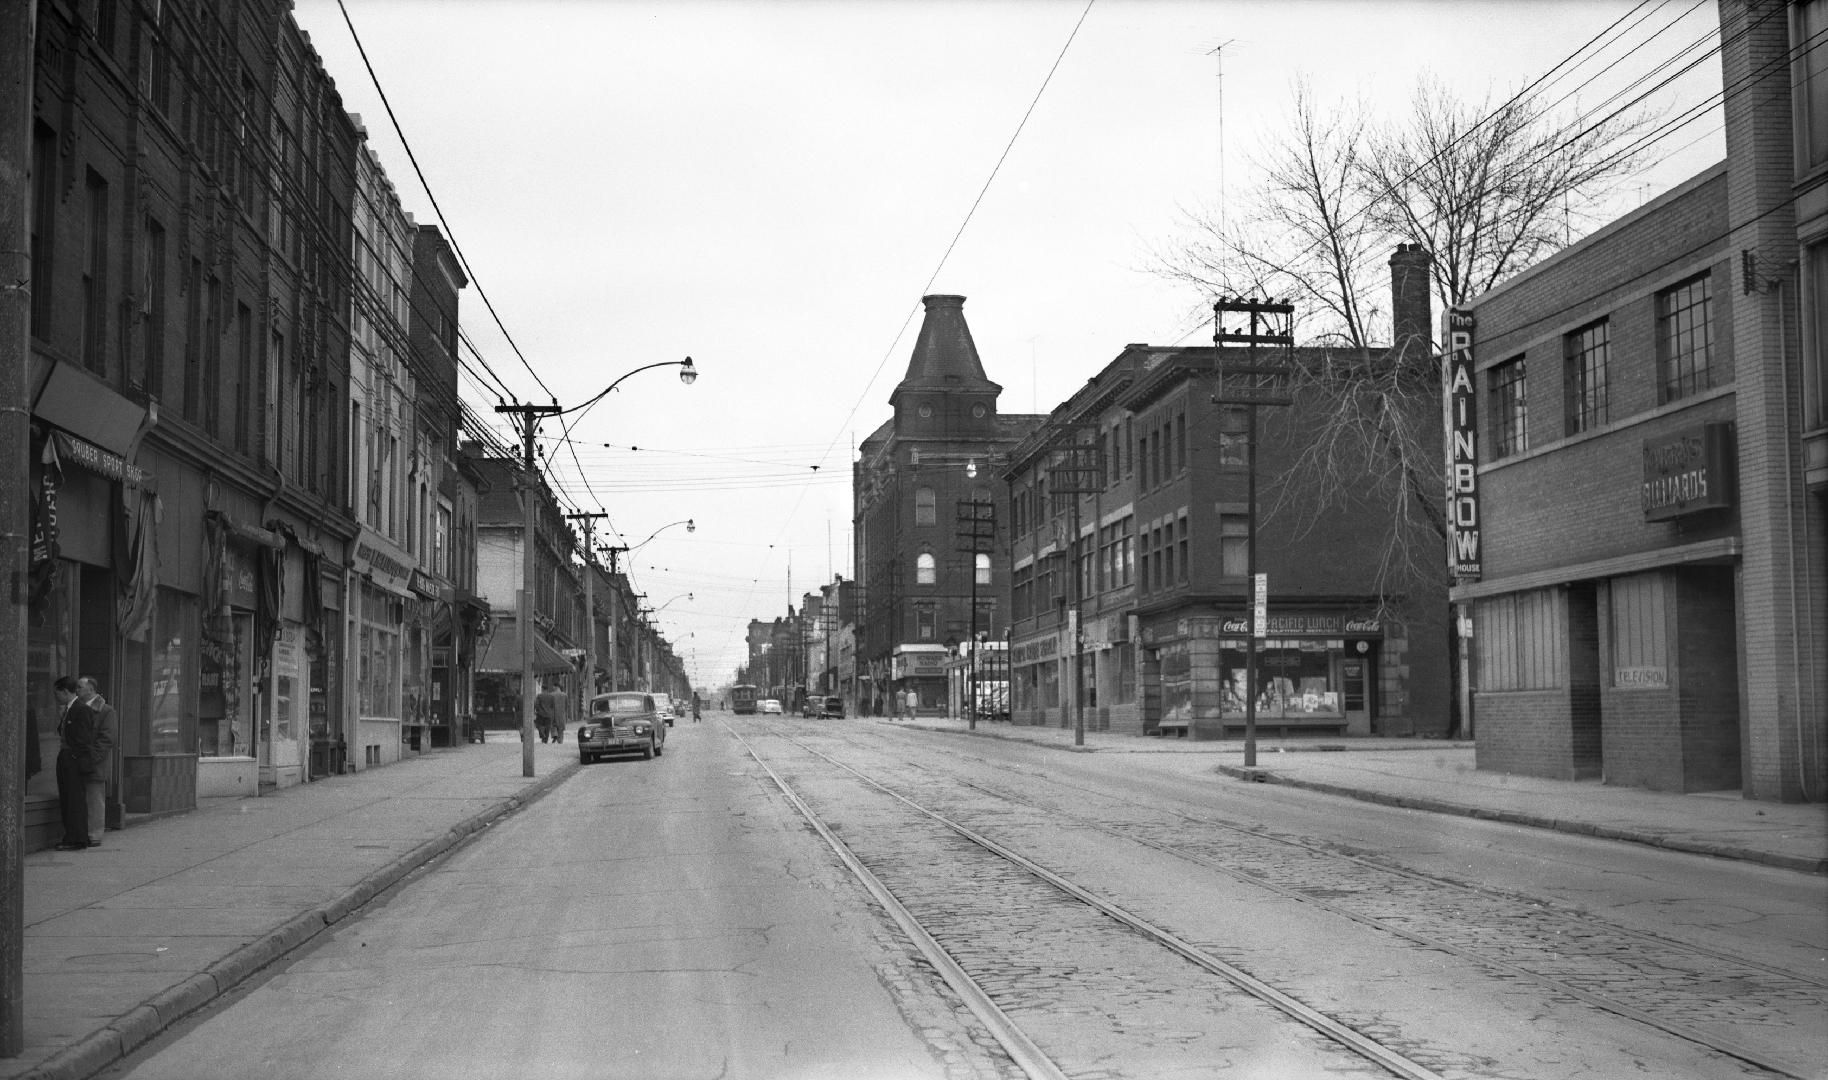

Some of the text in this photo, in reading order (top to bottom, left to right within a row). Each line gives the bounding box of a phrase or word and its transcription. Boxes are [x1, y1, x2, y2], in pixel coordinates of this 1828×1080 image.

[1450, 313, 1473, 327] The
[1452, 332, 1479, 561] RAINBOW
[1643, 468, 1707, 509] BILLIARDS
[1456, 563, 1480, 573] HOUSE
[1306, 616, 1340, 629] LUNCH
[1617, 671, 1665, 682] TELEVISION
